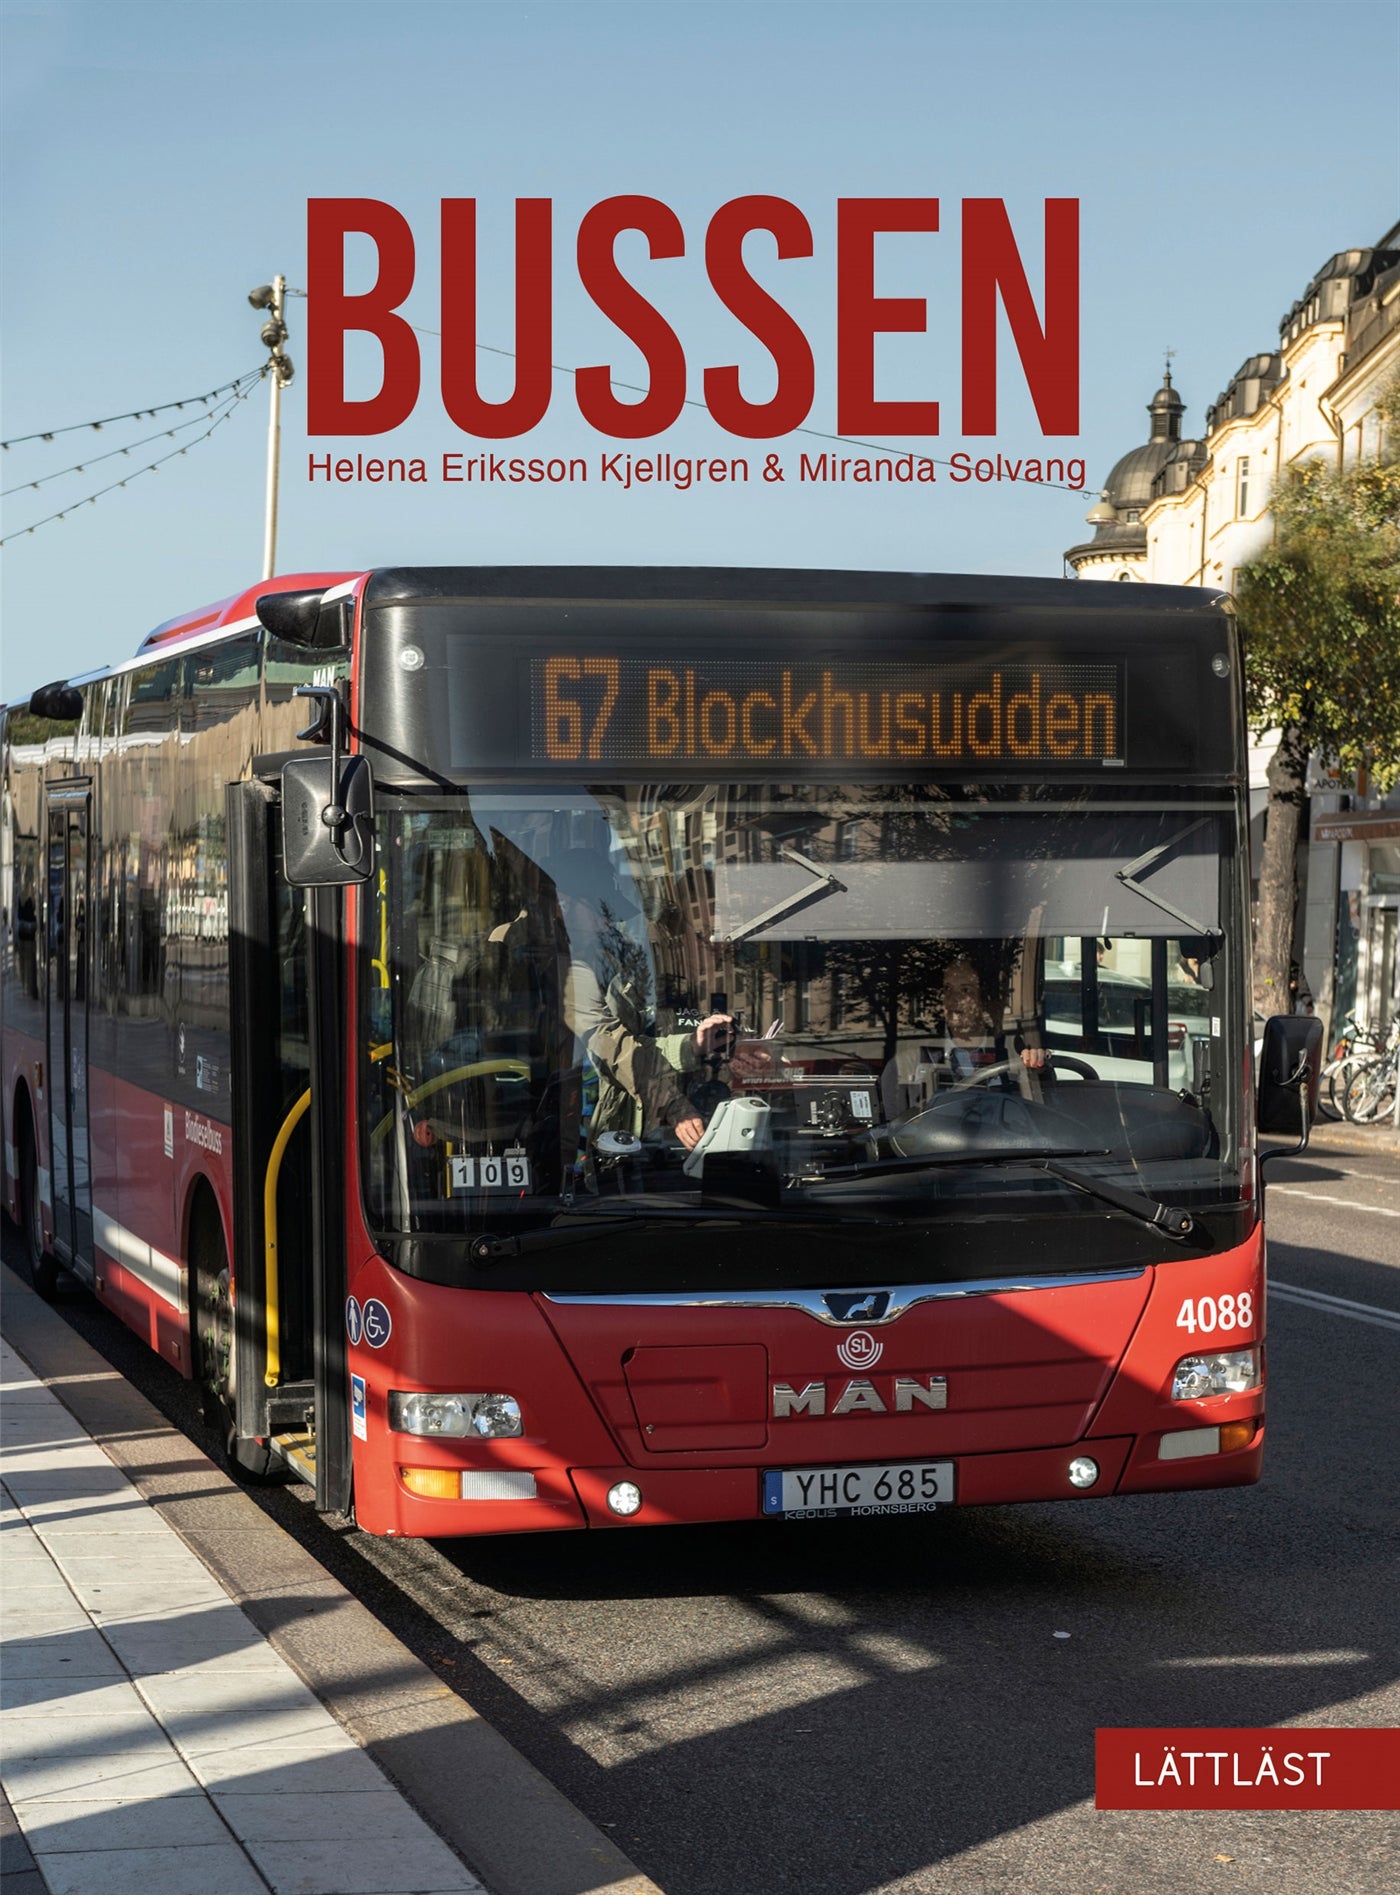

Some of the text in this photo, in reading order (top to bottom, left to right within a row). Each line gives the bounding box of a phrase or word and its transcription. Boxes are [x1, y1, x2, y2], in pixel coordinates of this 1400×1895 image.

[545, 657, 1117, 760] 67 Blockhusudden
[1176, 1292, 1253, 1334] 4088
[850, 1338, 871, 1353] SL
[772, 1375, 948, 1417] MAN
[796, 1468, 939, 1506] YHC 685
[850, 1502, 937, 1516] HORNSBERG
